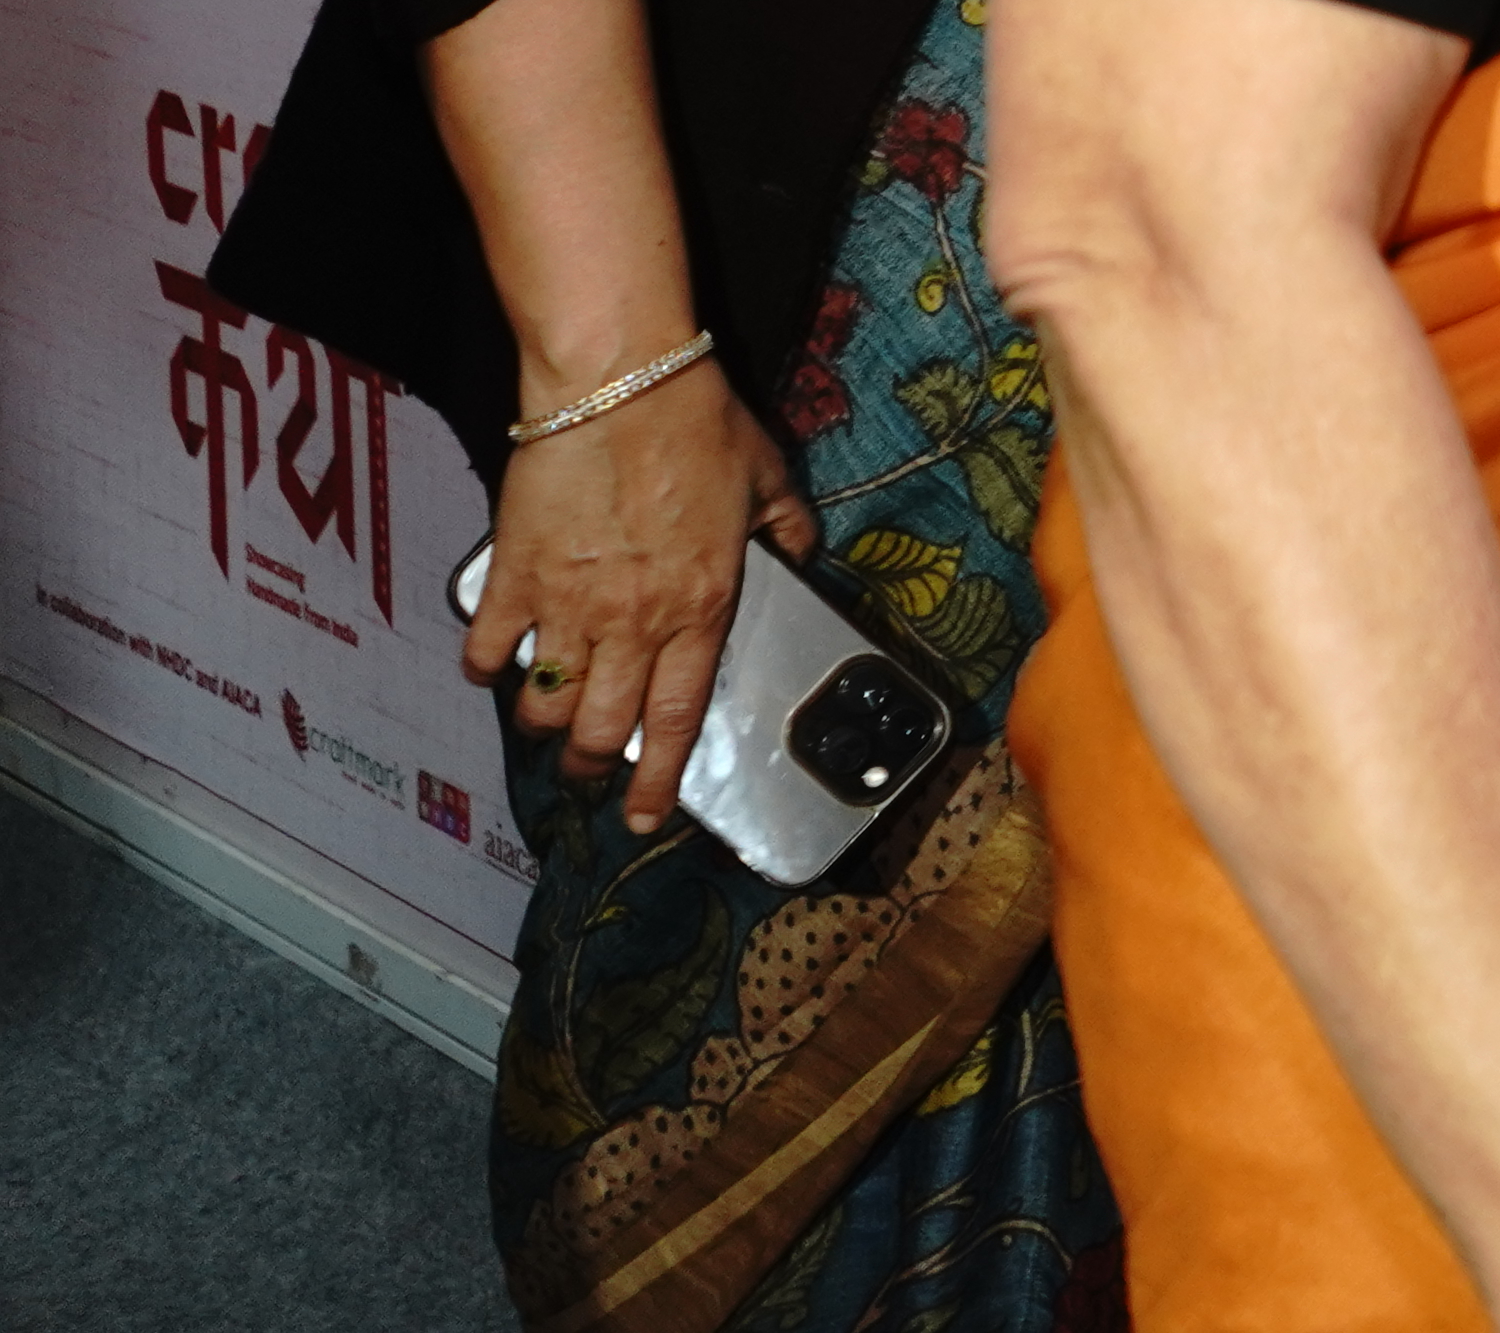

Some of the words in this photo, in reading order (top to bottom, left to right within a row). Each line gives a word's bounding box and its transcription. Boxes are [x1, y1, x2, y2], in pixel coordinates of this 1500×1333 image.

[49, 592, 126, 646] collaboration
[129, 634, 153, 664] with
[156, 642, 193, 682] NHDC
[195, 669, 219, 696] and
[222, 679, 262, 720] AIACA
